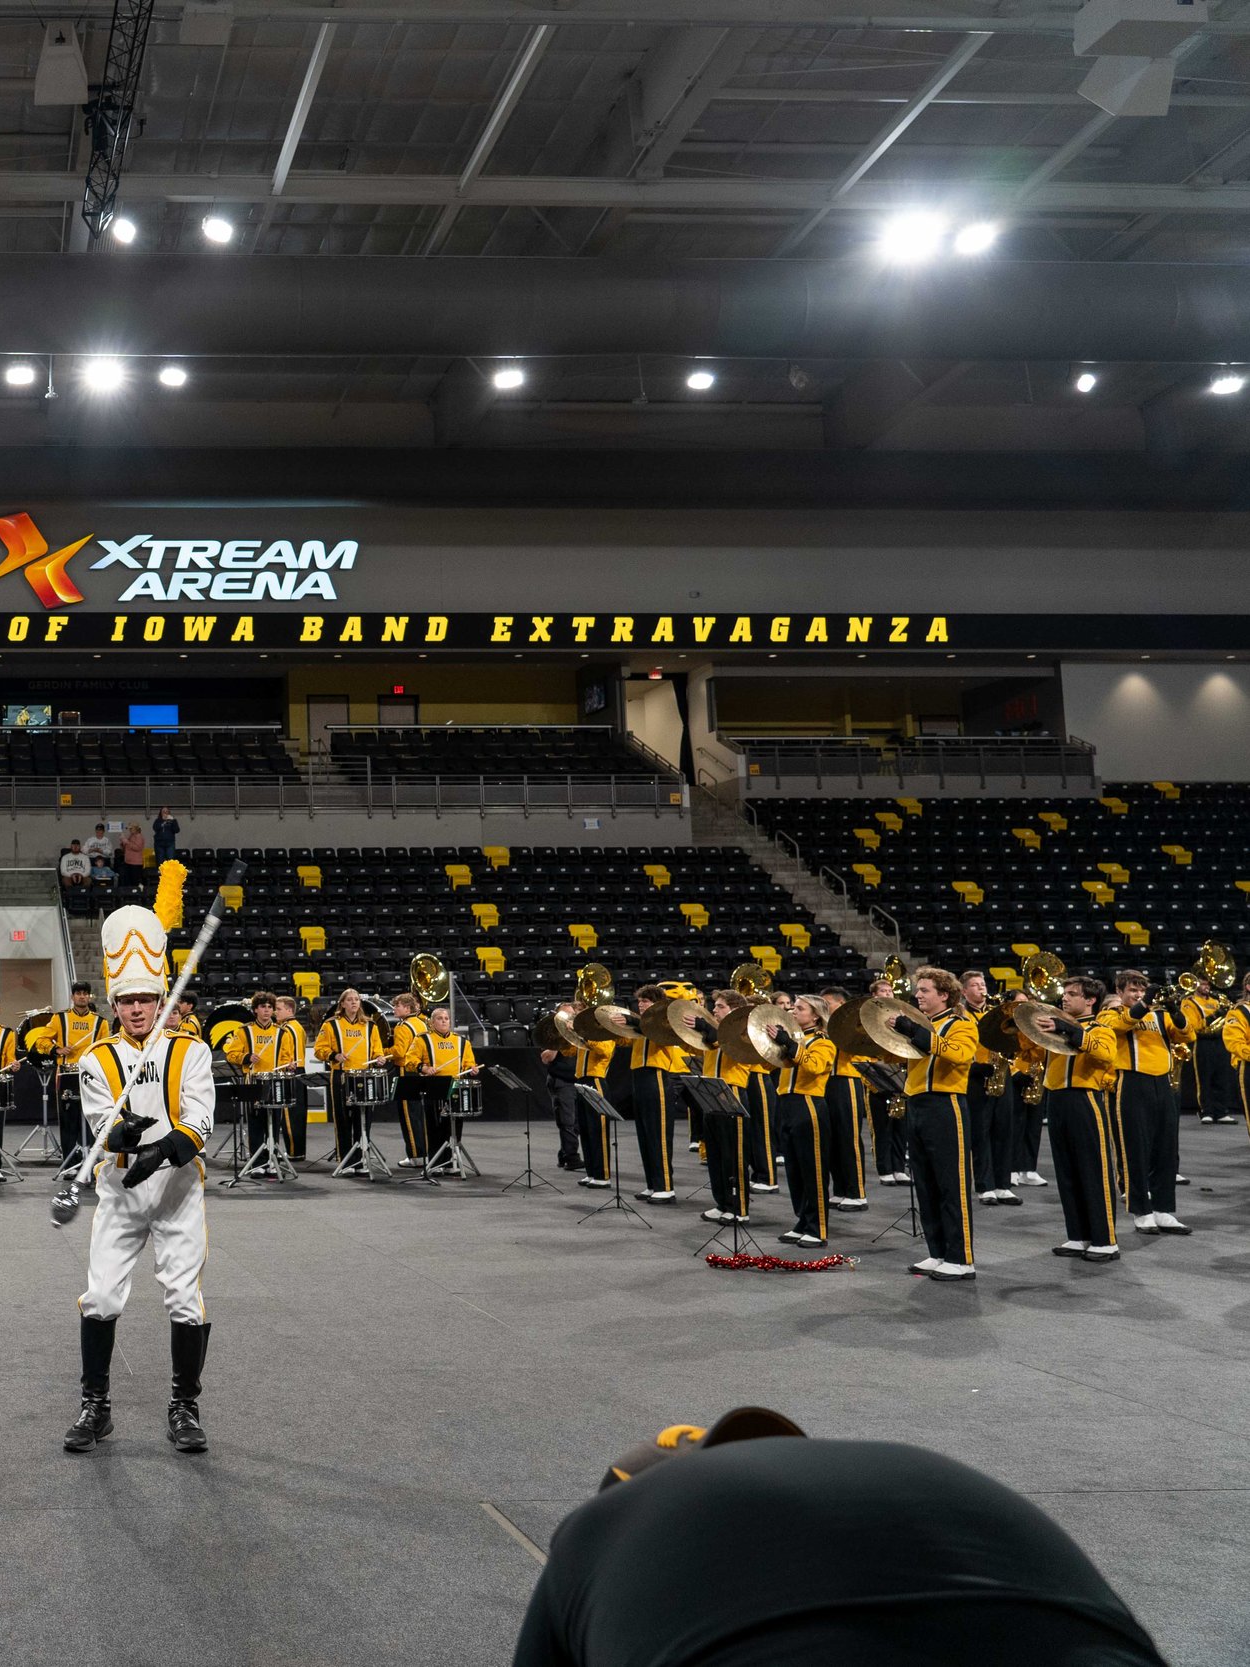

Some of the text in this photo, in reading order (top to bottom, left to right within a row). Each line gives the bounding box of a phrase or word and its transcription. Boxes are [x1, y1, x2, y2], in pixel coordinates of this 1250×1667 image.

[89, 534, 359, 569] XTREAM
[117, 571, 338, 602] ARENA
[7, 616, 68, 641] OF
[110, 616, 254, 641] IOWA
[299, 616, 448, 641] BAND
[490, 616, 948, 642] EXTRAVAGANZA
[28, 680, 149, 690] GERDIN FAMILY CLUB
[67, 859, 84, 868] IOWA
[72, 1021, 90, 1031] IOWA
